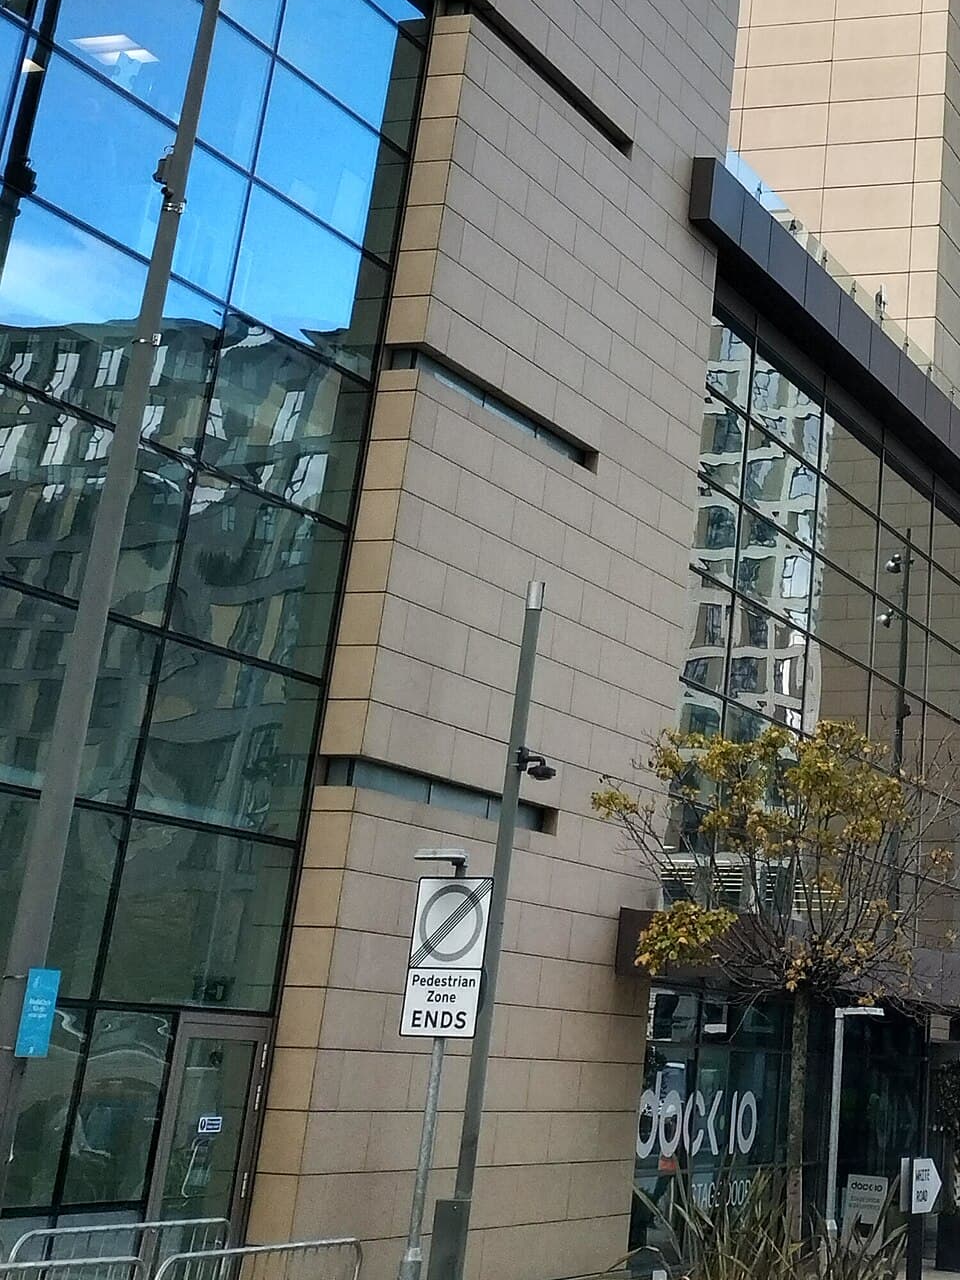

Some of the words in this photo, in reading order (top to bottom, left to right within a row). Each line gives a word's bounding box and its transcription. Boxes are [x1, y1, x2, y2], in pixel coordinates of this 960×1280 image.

[411, 974, 476, 988] Pedestrian
[426, 990, 457, 1004] Zone
[411, 1010, 467, 1030] ENDS
